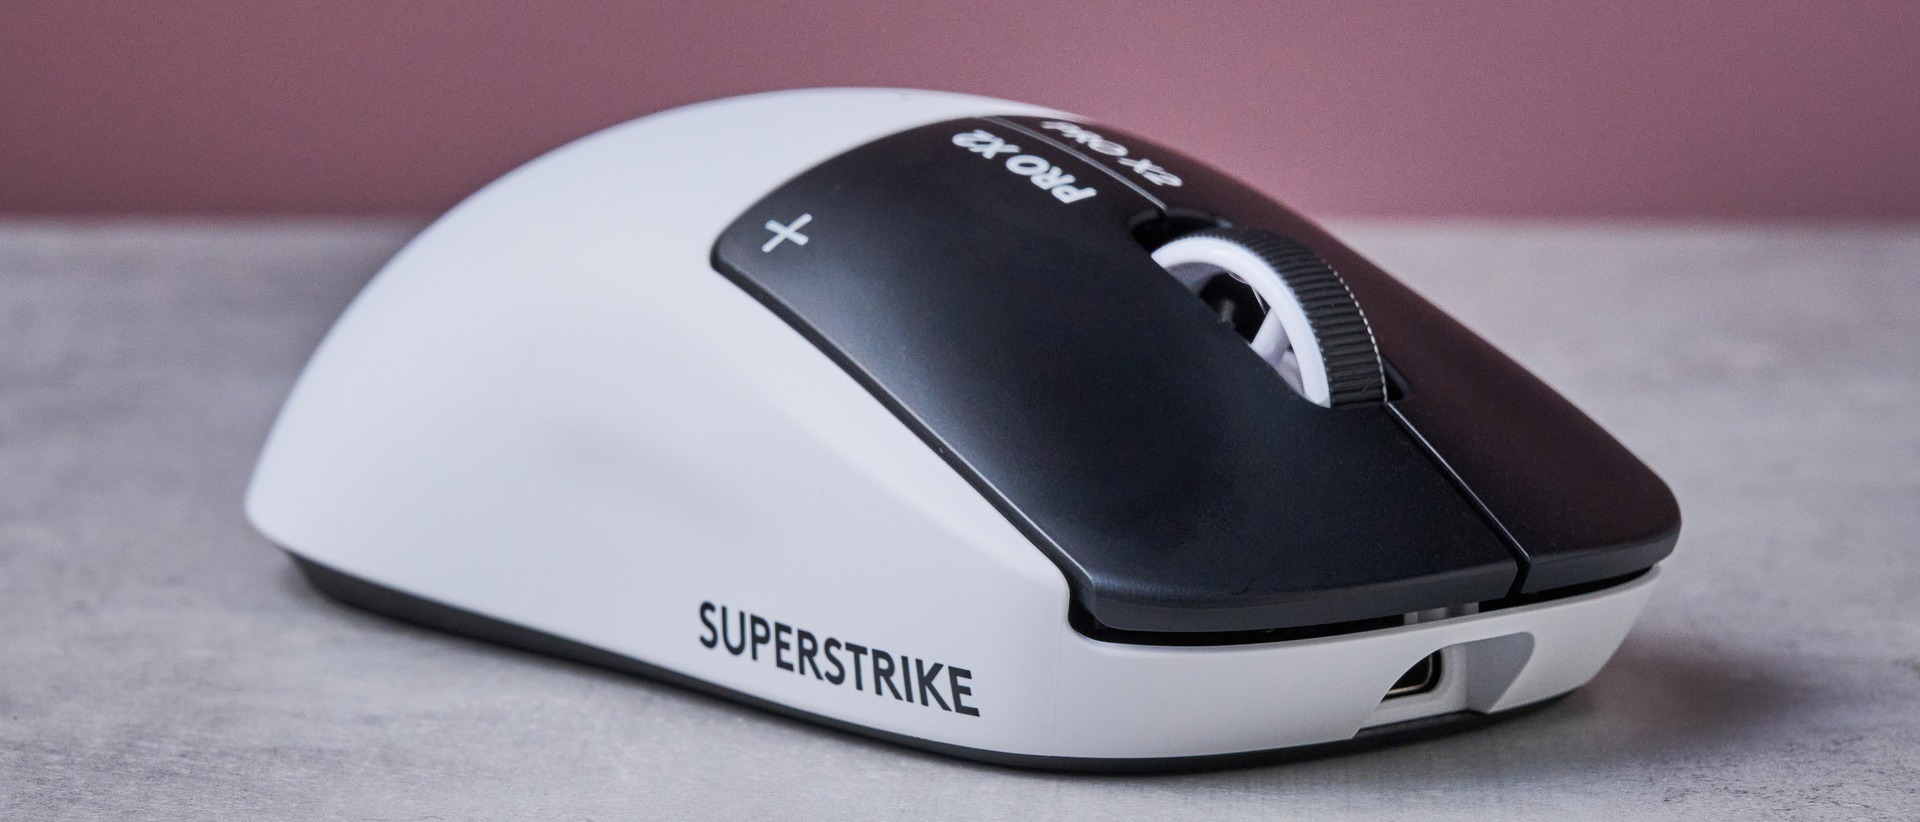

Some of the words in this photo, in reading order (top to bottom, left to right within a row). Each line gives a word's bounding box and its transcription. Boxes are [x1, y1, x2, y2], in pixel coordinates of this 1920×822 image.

[951, 129, 1021, 159] X2
[1005, 154, 1097, 204] PRO
[698, 600, 981, 717] SUPERSTRIKE
